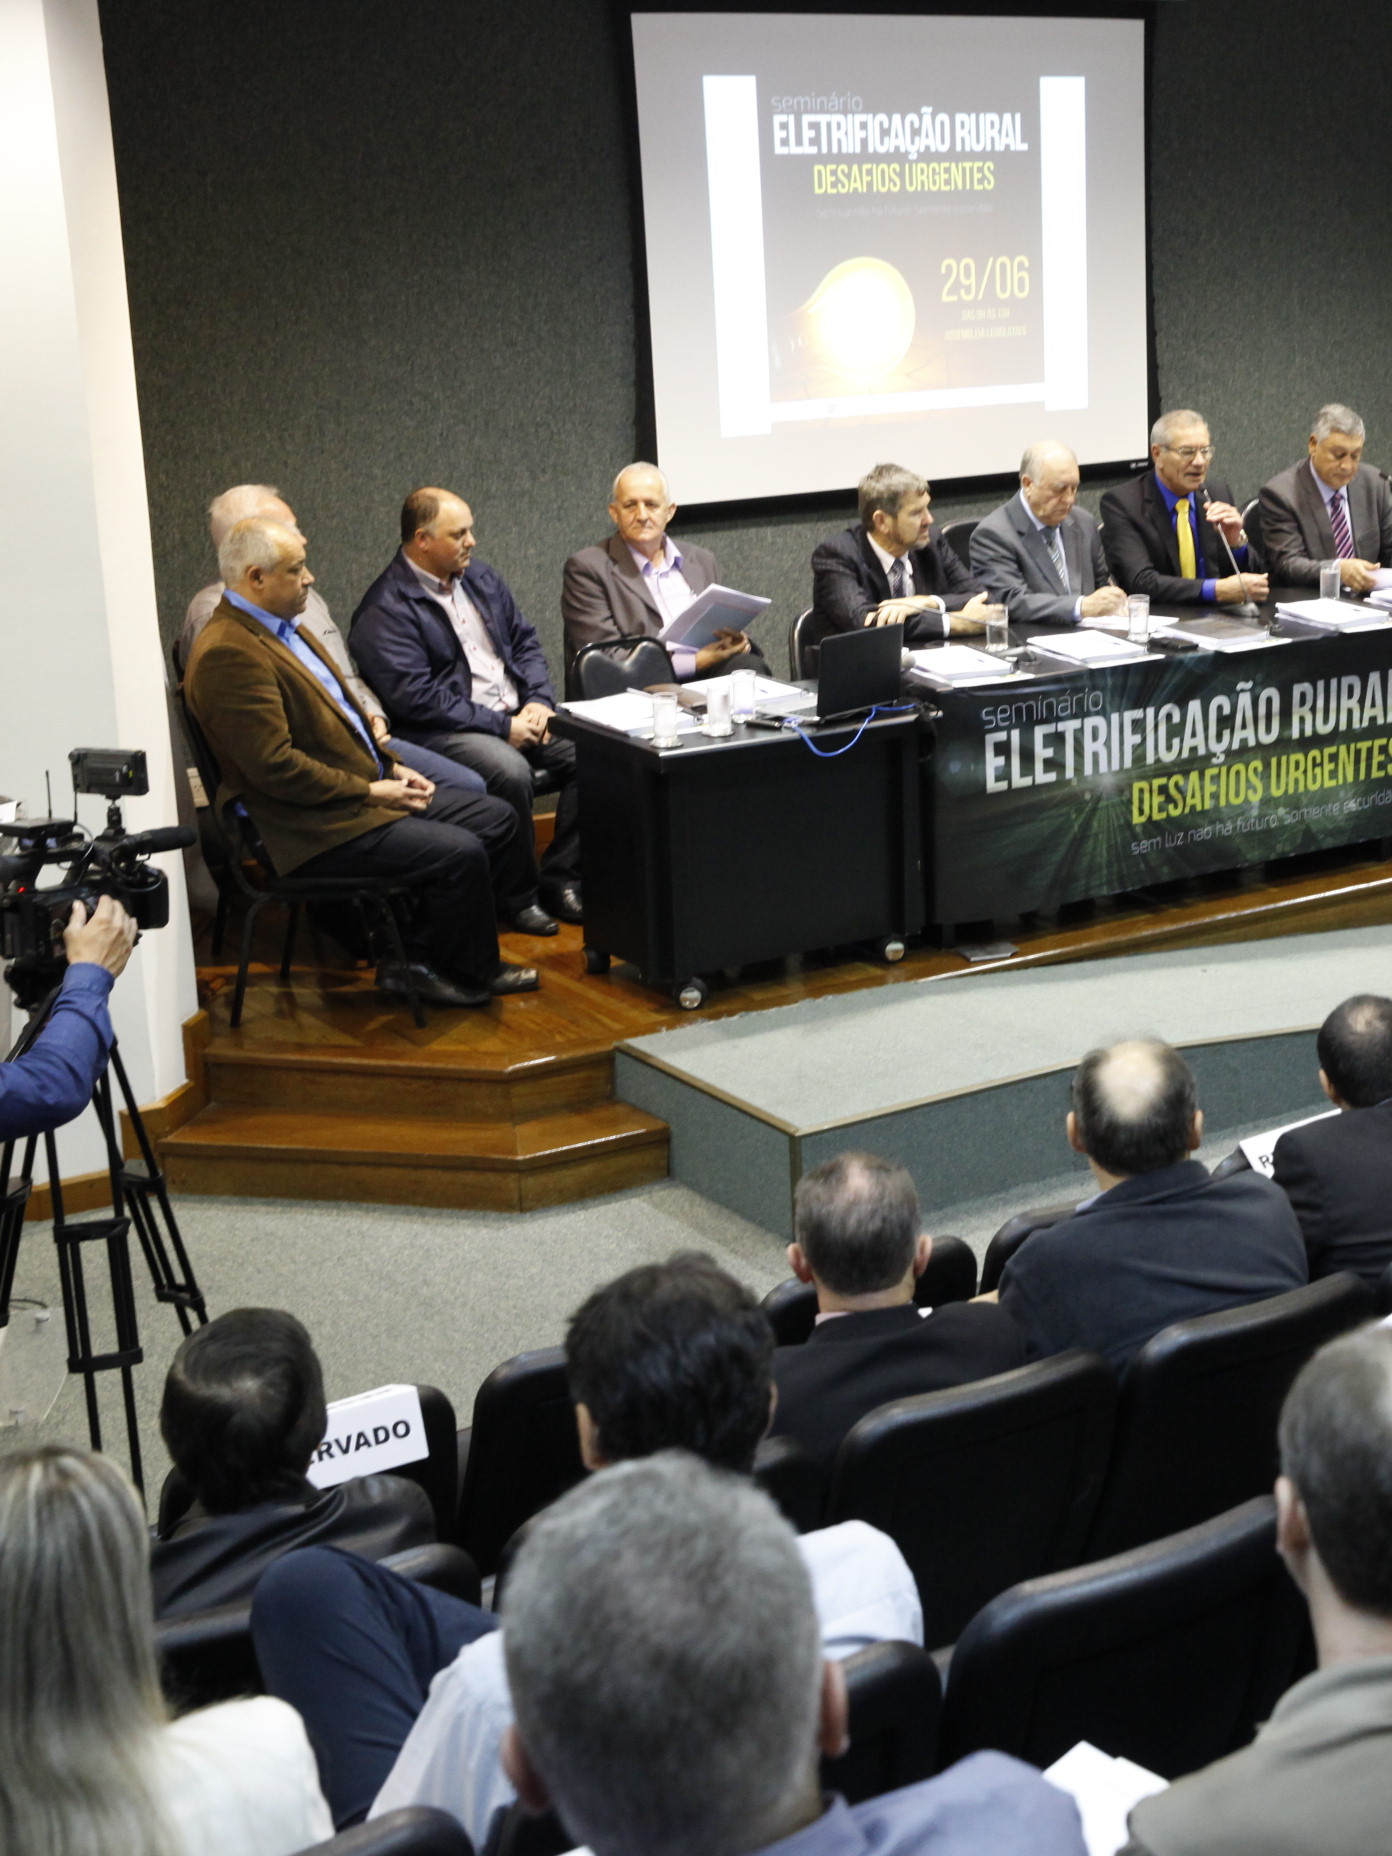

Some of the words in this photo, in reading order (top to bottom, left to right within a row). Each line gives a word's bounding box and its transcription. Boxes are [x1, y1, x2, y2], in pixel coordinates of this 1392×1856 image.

[771, 91, 863, 113] seminário
[772, 106, 950, 160] ELETRIFICAÇÃO
[955, 112, 1029, 152] RURAL
[813, 163, 900, 194] DESAFIOS
[905, 161, 995, 192] URGENTES
[940, 255, 1030, 303] 29/06
[981, 687, 1104, 730] seminário
[984, 680, 1281, 795] ELETRIFICAÇÃO
[1131, 760, 1264, 824] DESAFIOS
[1131, 836, 1162, 855] sem
[1165, 832, 1184, 849] luz
[1215, 819, 1233, 837] há
[1283, 802, 1340, 825] Somente
[310, 1419, 411, 1465] RVADO
